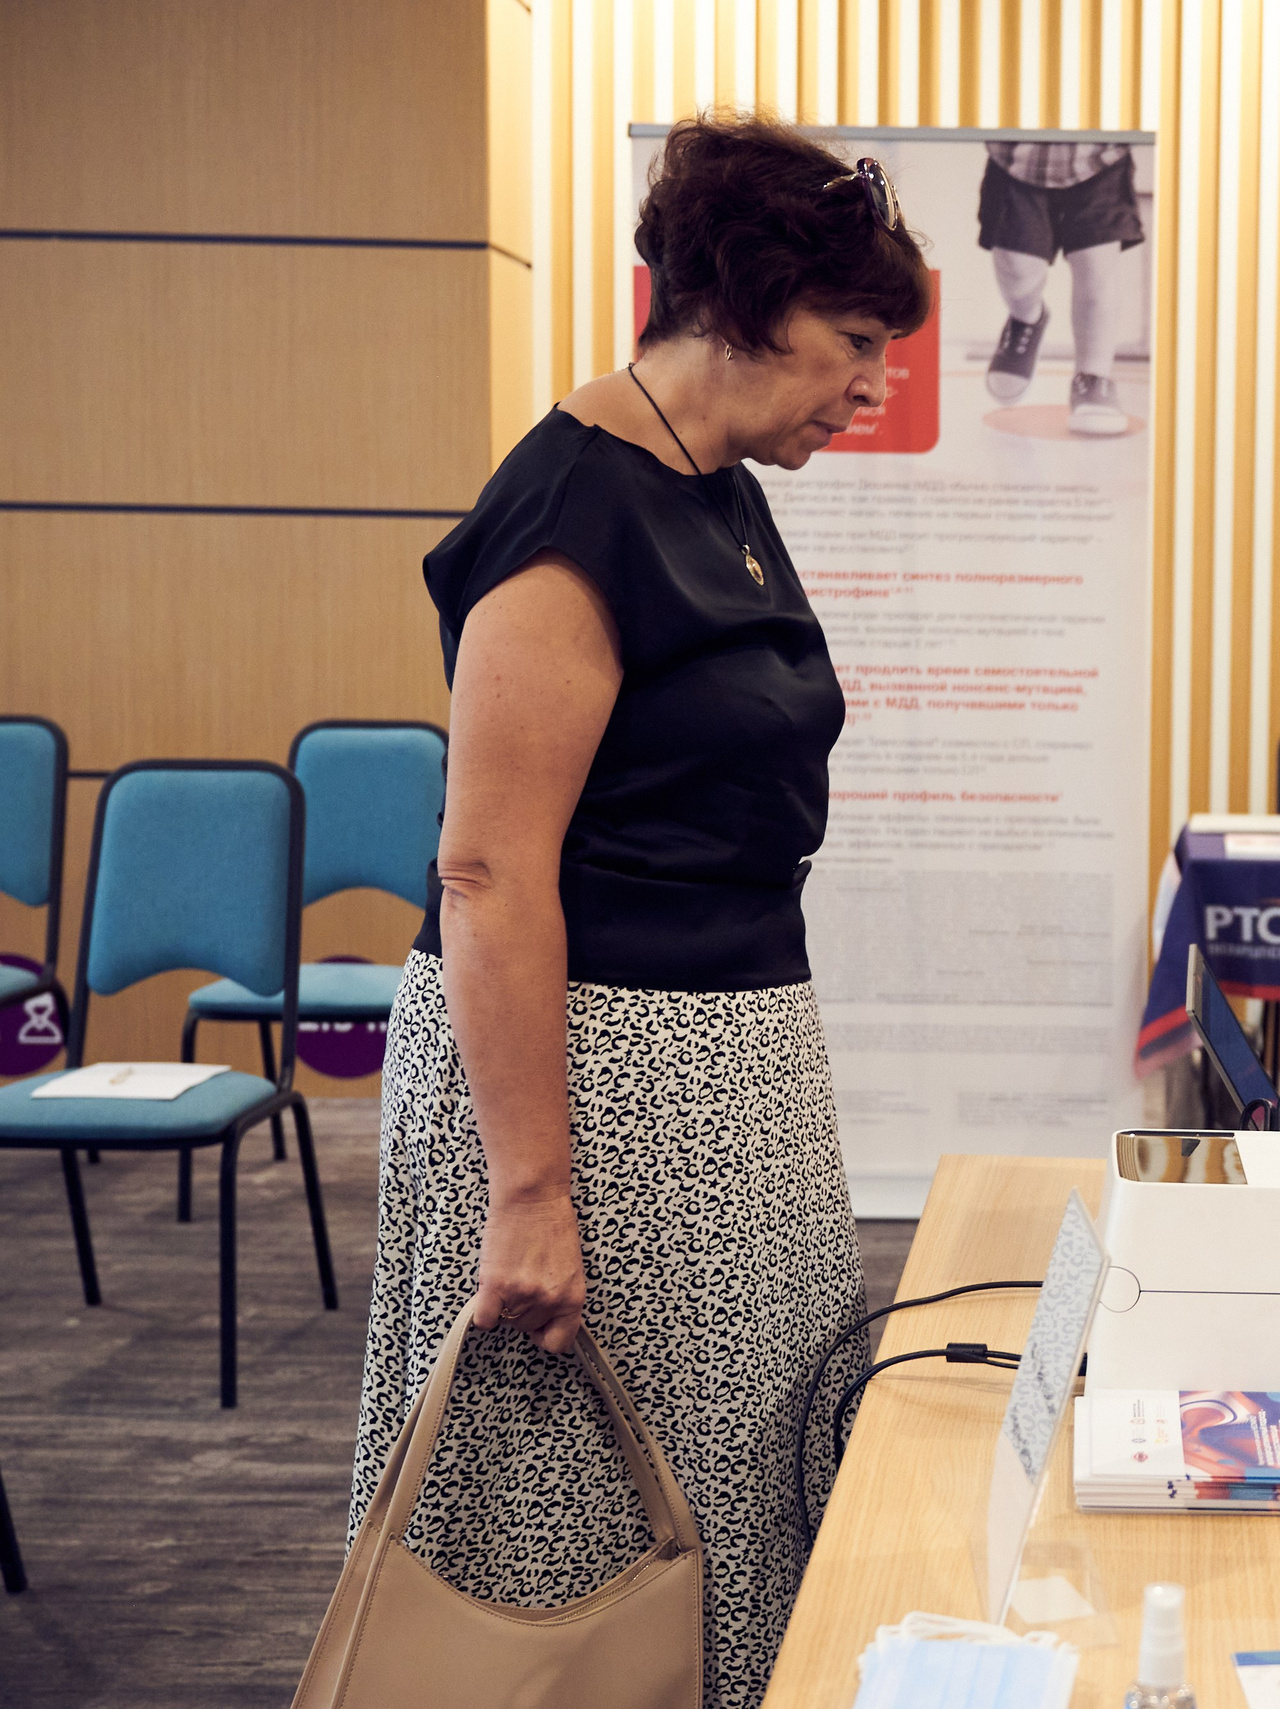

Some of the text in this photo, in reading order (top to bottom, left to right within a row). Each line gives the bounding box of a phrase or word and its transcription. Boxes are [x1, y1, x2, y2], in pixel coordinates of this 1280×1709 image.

[855, 665, 922, 676] продлить
[926, 666, 970, 677] время
[892, 790, 956, 803] профиль
